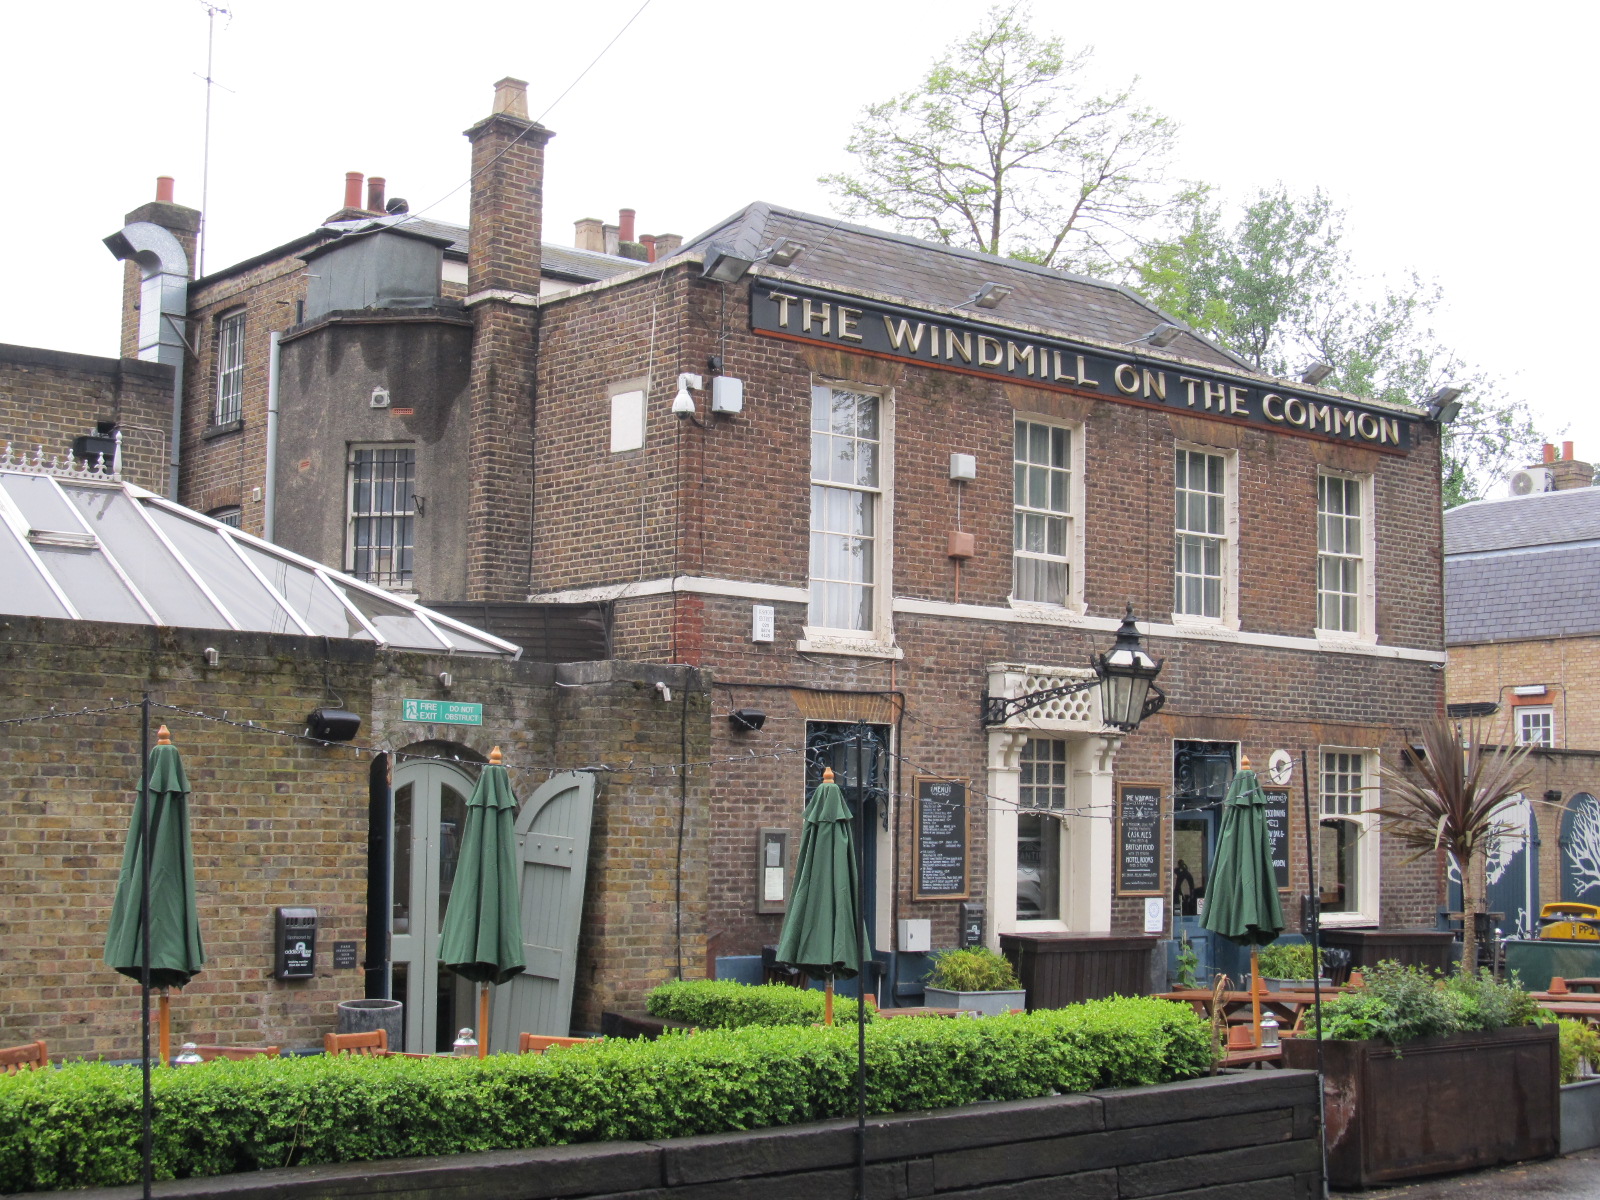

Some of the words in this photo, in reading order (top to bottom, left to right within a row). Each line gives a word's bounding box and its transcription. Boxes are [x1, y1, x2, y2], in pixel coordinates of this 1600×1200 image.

[770, 292, 863, 342] THE
[883, 315, 1098, 388] WINDMILL
[1114, 363, 1166, 401] ON
[1180, 375, 1250, 415] THE
[1262, 393, 1399, 446] COMMON
[421, 703, 438, 711] FIRE
[449, 705, 459, 713] DO
[461, 706, 474, 714] NOT
[420, 711, 437, 720] EXIT
[444, 713, 478, 722] OBSTRUCT
[933, 785, 949, 794] MENU
